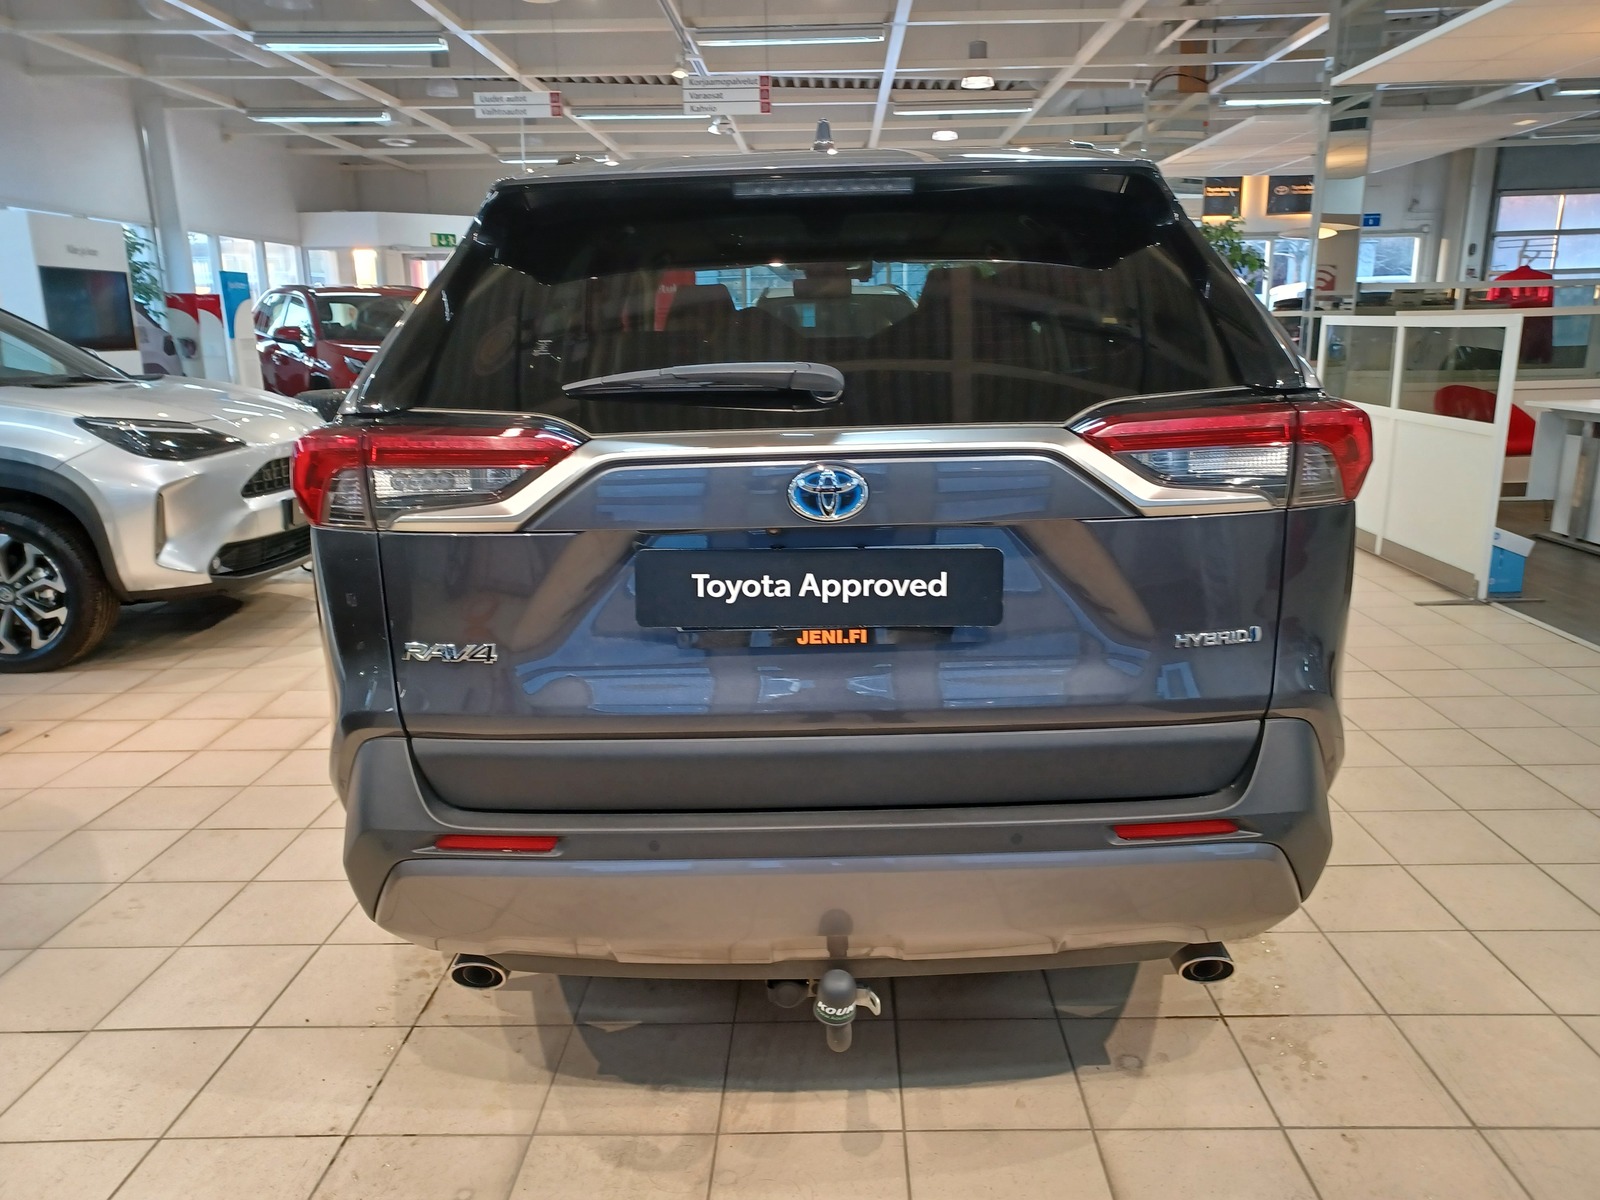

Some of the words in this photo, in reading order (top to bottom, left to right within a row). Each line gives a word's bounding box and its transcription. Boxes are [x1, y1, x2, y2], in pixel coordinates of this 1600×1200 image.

[689, 92, 724, 100] Varaosat
[691, 573, 791, 604] Toyota
[798, 572, 948, 603] Approved
[796, 628, 868, 645] JENI.FI
[1174, 629, 1249, 648] HYBRID
[402, 641, 498, 664] RAV4
